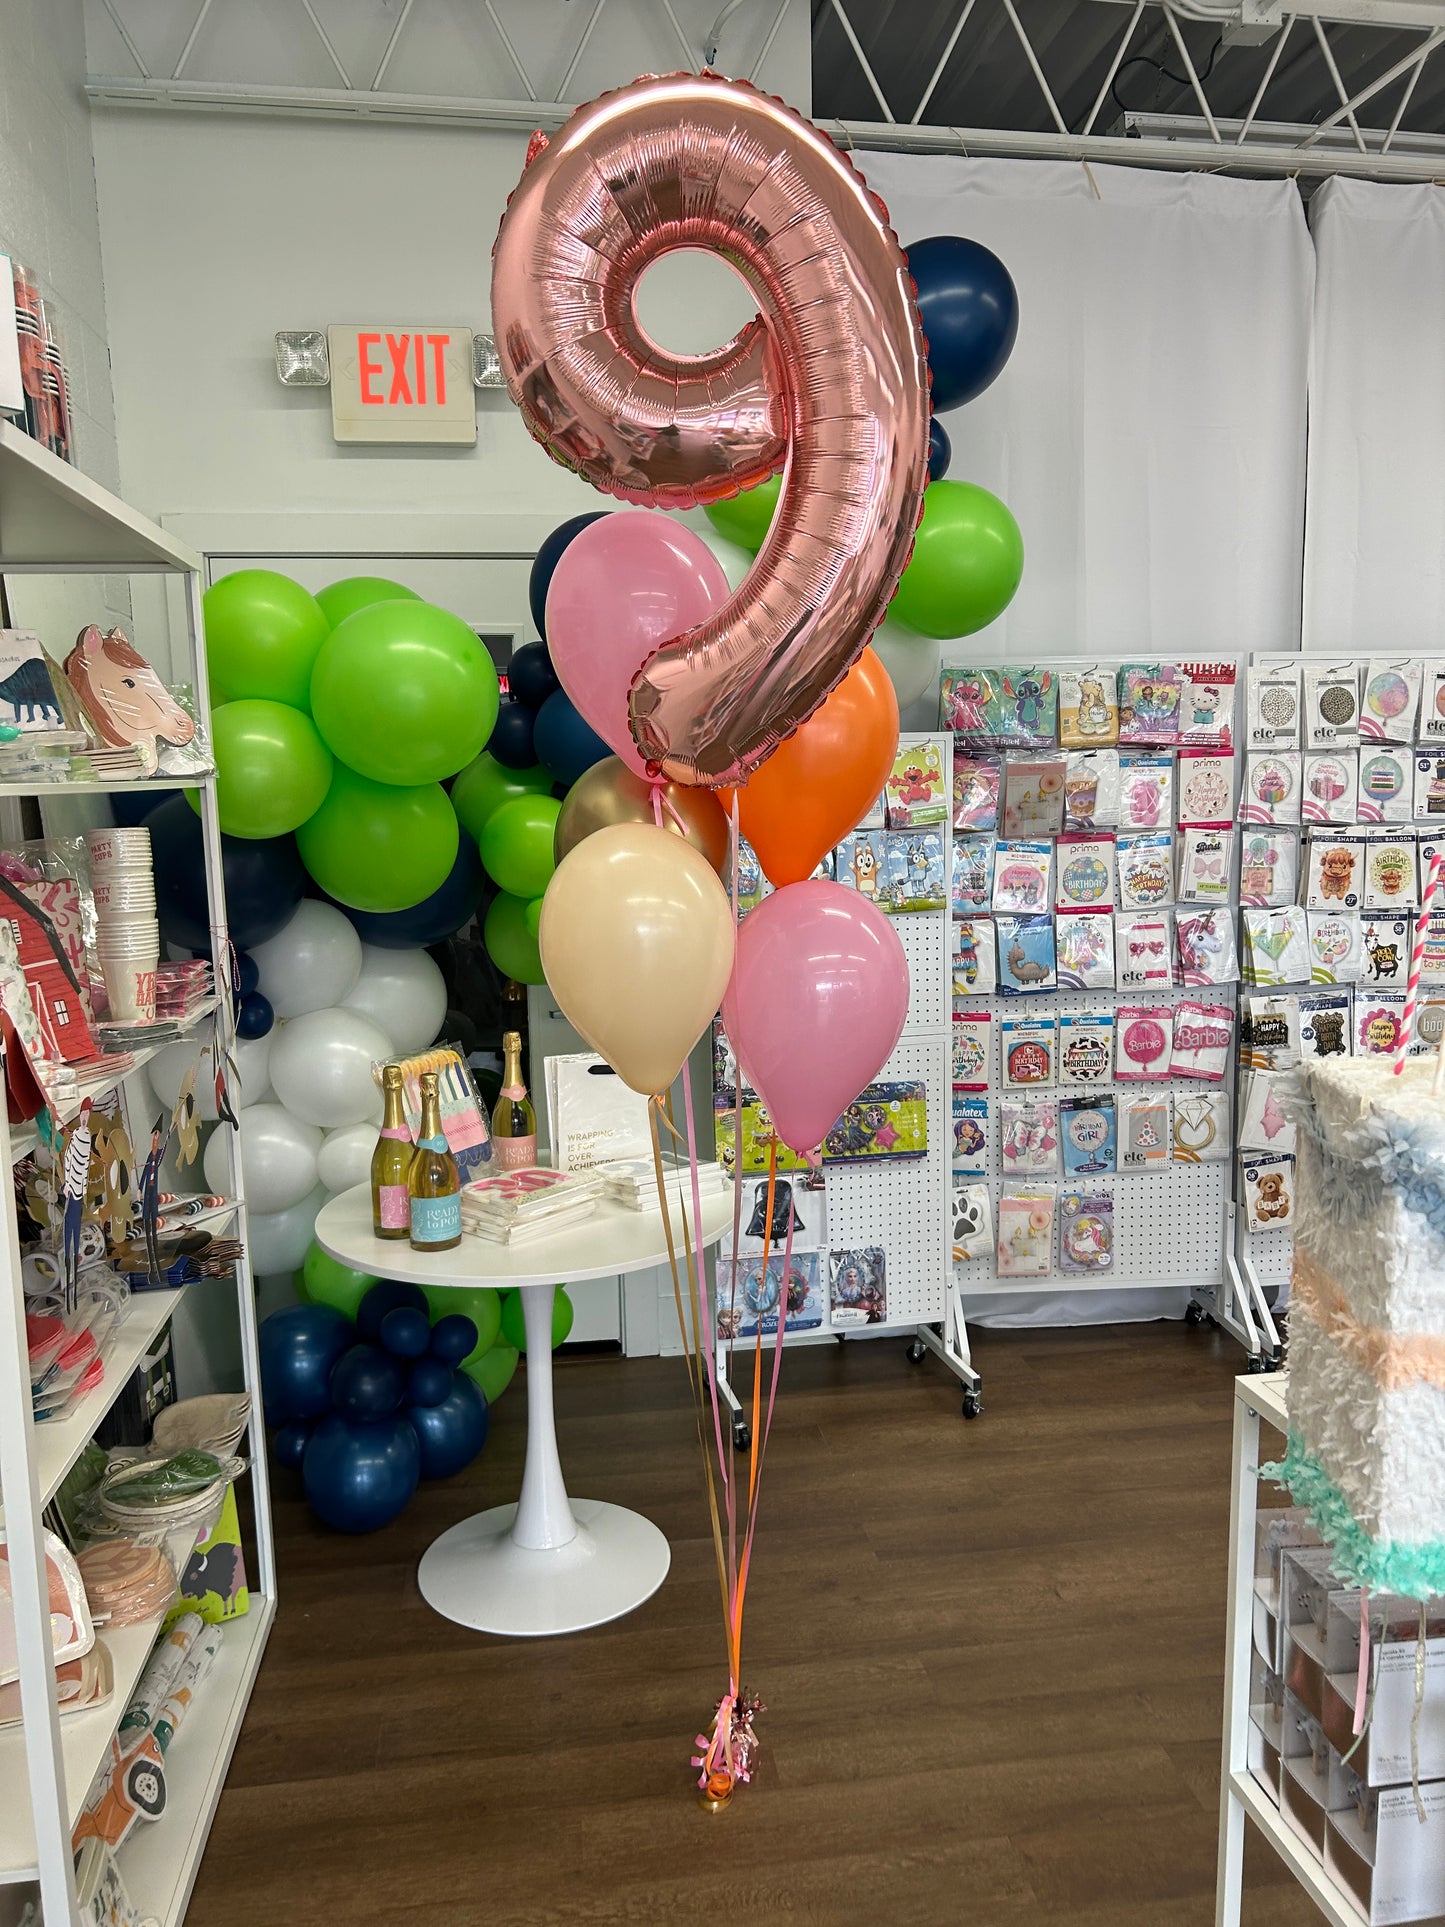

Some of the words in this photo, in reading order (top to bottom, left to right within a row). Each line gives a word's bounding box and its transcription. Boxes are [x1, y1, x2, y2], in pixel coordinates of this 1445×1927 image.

[358, 333, 450, 405] EXIT
[1253, 728, 1276, 738] etc.
[1314, 727, 1337, 738] etc.
[1193, 758, 1221, 769] prima
[1070, 844, 1100, 855] prima
[95, 851, 112, 861] CUPS
[1376, 855, 1407, 867] BIRTHDAY
[1068, 879, 1103, 889] BIRTHDAY
[1130, 873, 1151, 885] HAPPY
[1377, 947, 1394, 956] HOLY
[1426, 945, 1445, 953] Birth
[952, 957, 970, 966] APPY
[1424, 960, 1433, 968] to
[1122, 971, 1146, 981] etc.
[135, 971, 156, 993] YE
[1182, 1004, 1202, 1013] Barbie
[1020, 1022, 1041, 1030] Qualatex
[1261, 1023, 1280, 1031] HAPPY
[1371, 1023, 1393, 1034] happy
[1174, 1026, 1230, 1049] Barbie
[1320, 1032, 1337, 1041] BIRTH
[1128, 1040, 1161, 1052] Barbie
[952, 1056, 978, 1070] rthday
[1015, 1057, 1043, 1065] BIRTHDAY
[952, 1107, 984, 1119] ualatex
[567, 1129, 614, 1142] WRAPPING
[568, 1144, 576, 1152] IS
[577, 1142, 595, 1150] FOR
[1124, 1152, 1147, 1161] etc.
[427, 1221, 439, 1229] to
